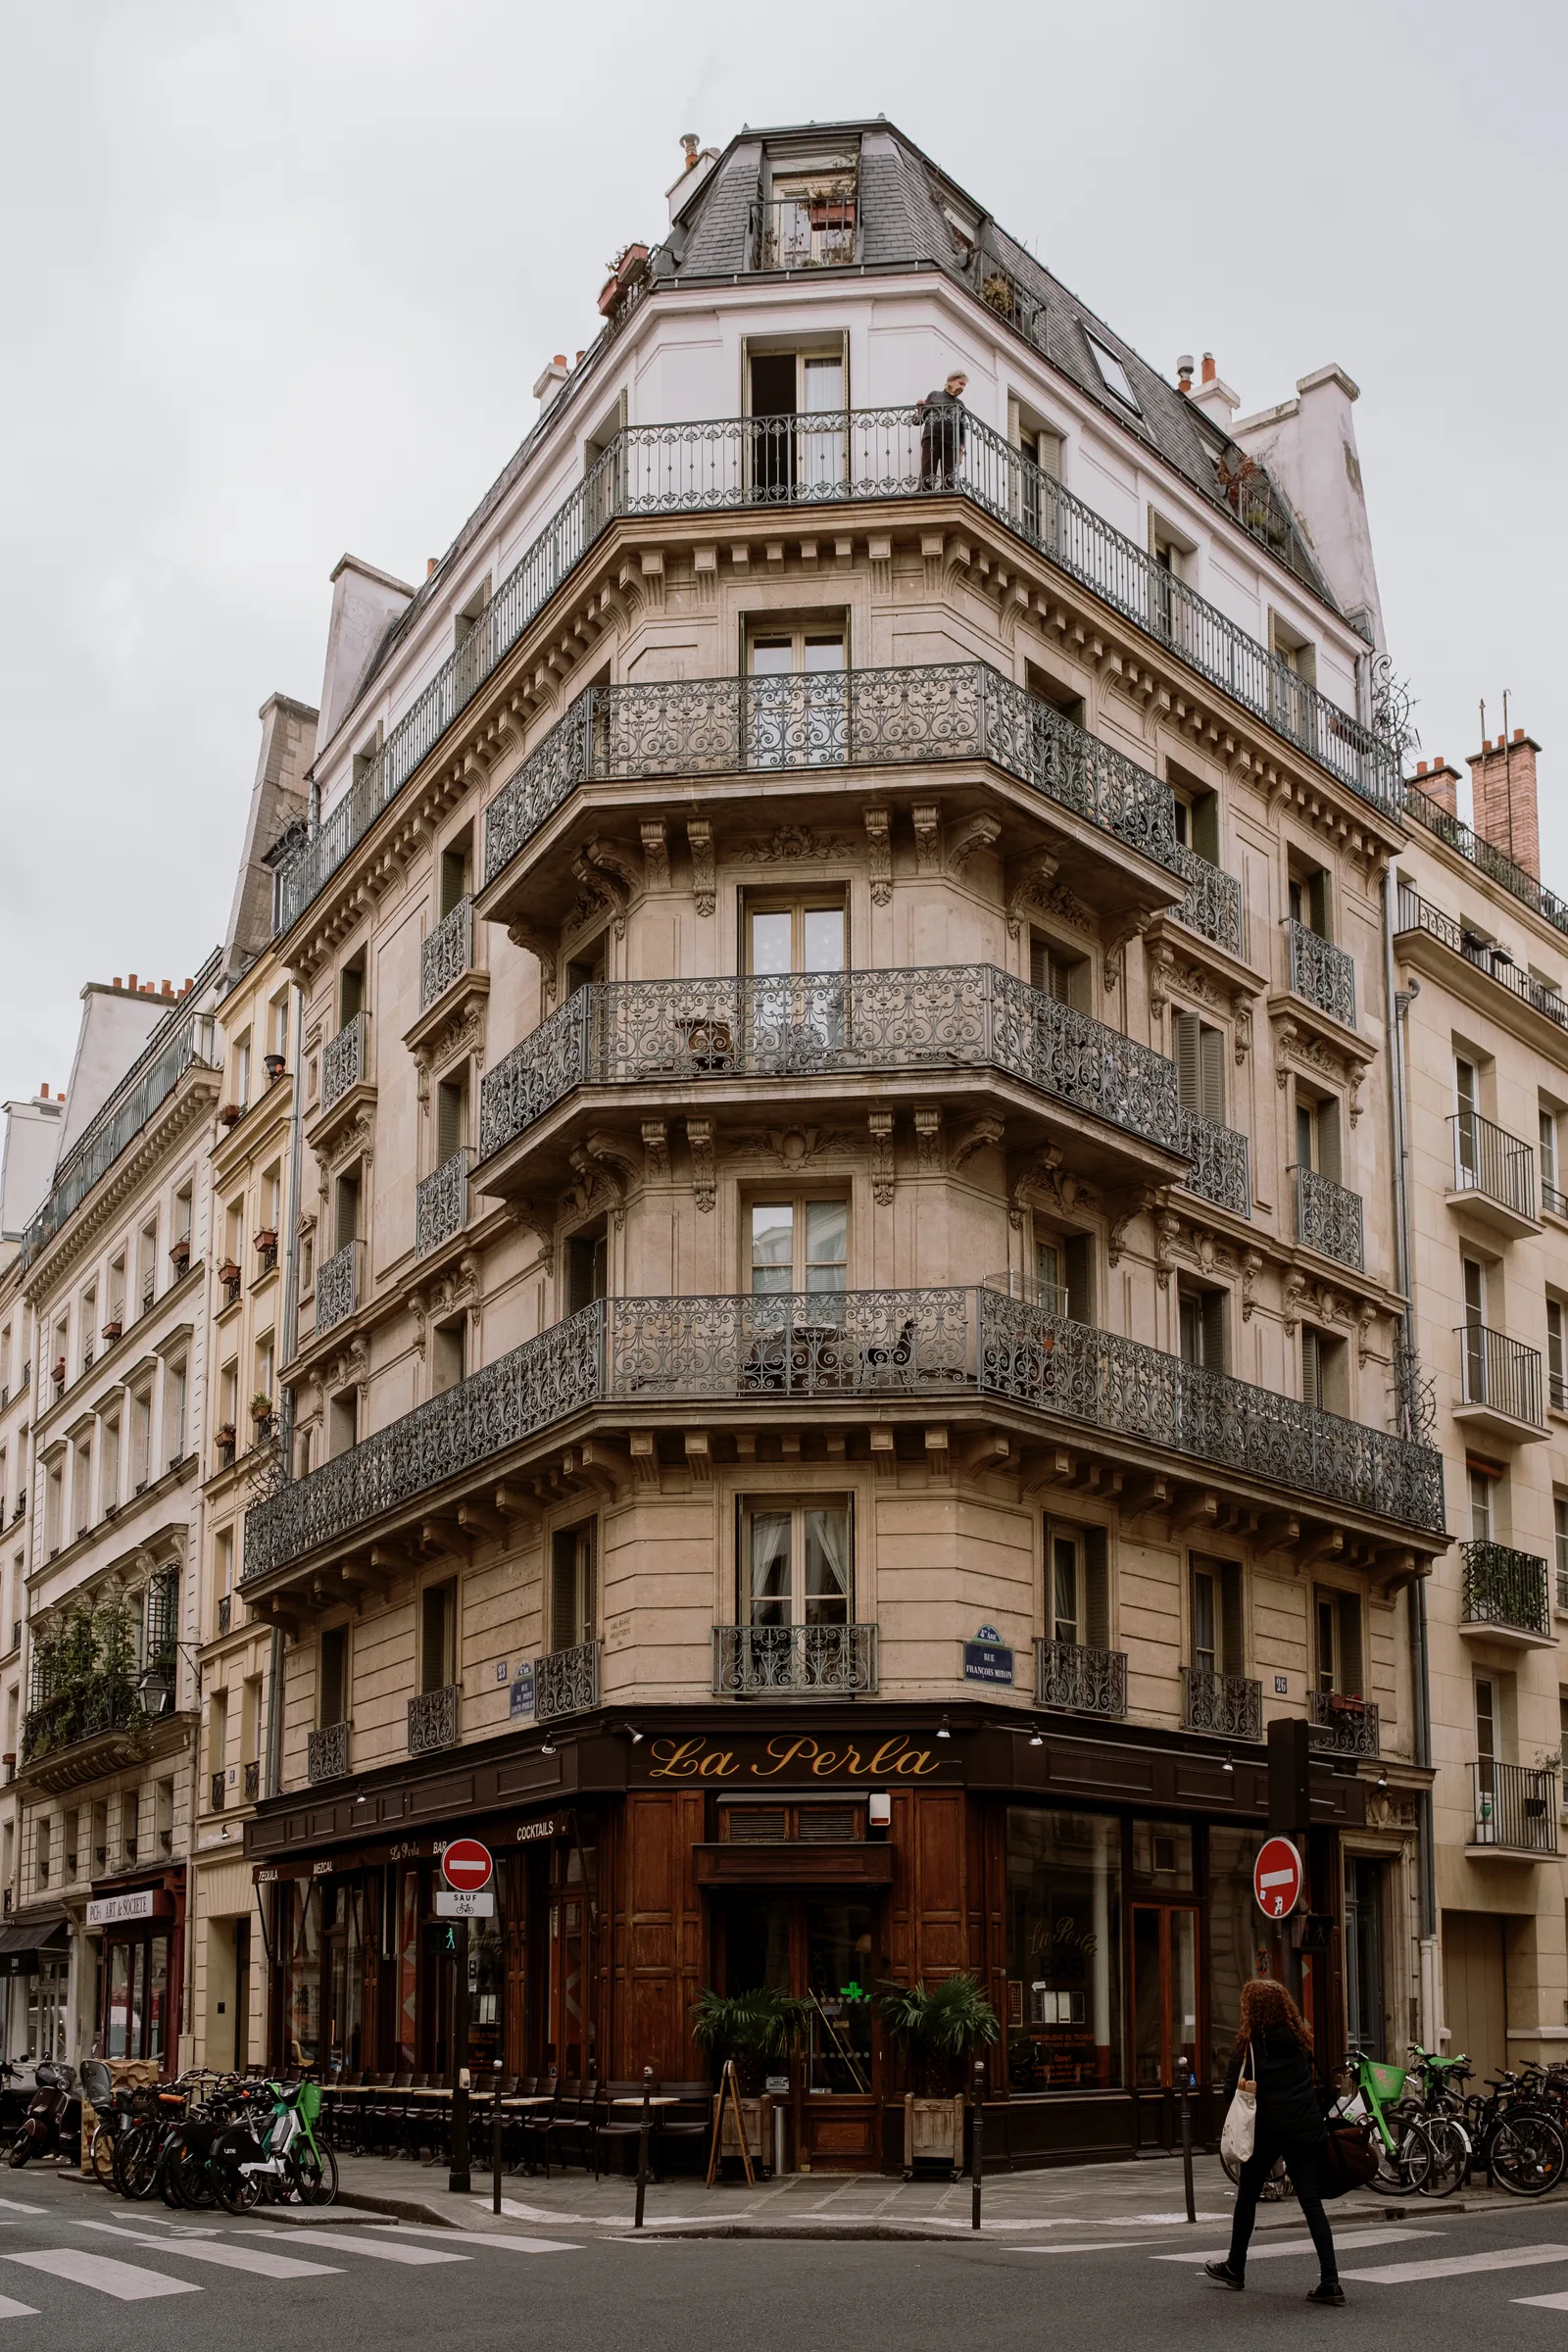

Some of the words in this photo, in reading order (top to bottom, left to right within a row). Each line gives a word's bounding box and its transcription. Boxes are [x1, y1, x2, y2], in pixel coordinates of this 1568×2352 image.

[983, 1652, 995, 1662] RUE
[498, 1664, 506, 1680] 23
[966, 1664, 994, 1678] FRANÇOIS
[994, 1669, 1011, 1679] MIRON
[1276, 1678, 1286, 1692] 26
[649, 1737, 739, 1777] La
[751, 1735, 940, 1776] Perla
[516, 1820, 554, 1841] COCKTAILS
[432, 1840, 448, 1854] BAR
[258, 1869, 278, 1882] TEQUILA
[313, 1861, 333, 1875] MEZCAL
[453, 1893, 477, 1902] SAUF
[106, 1902, 116, 1918] ART
[118, 1901, 122, 1916] &
[1027, 1921, 1052, 1960] La
[1053, 1916, 1098, 1957] Perla
[1040, 1956, 1085, 1979] BAR
